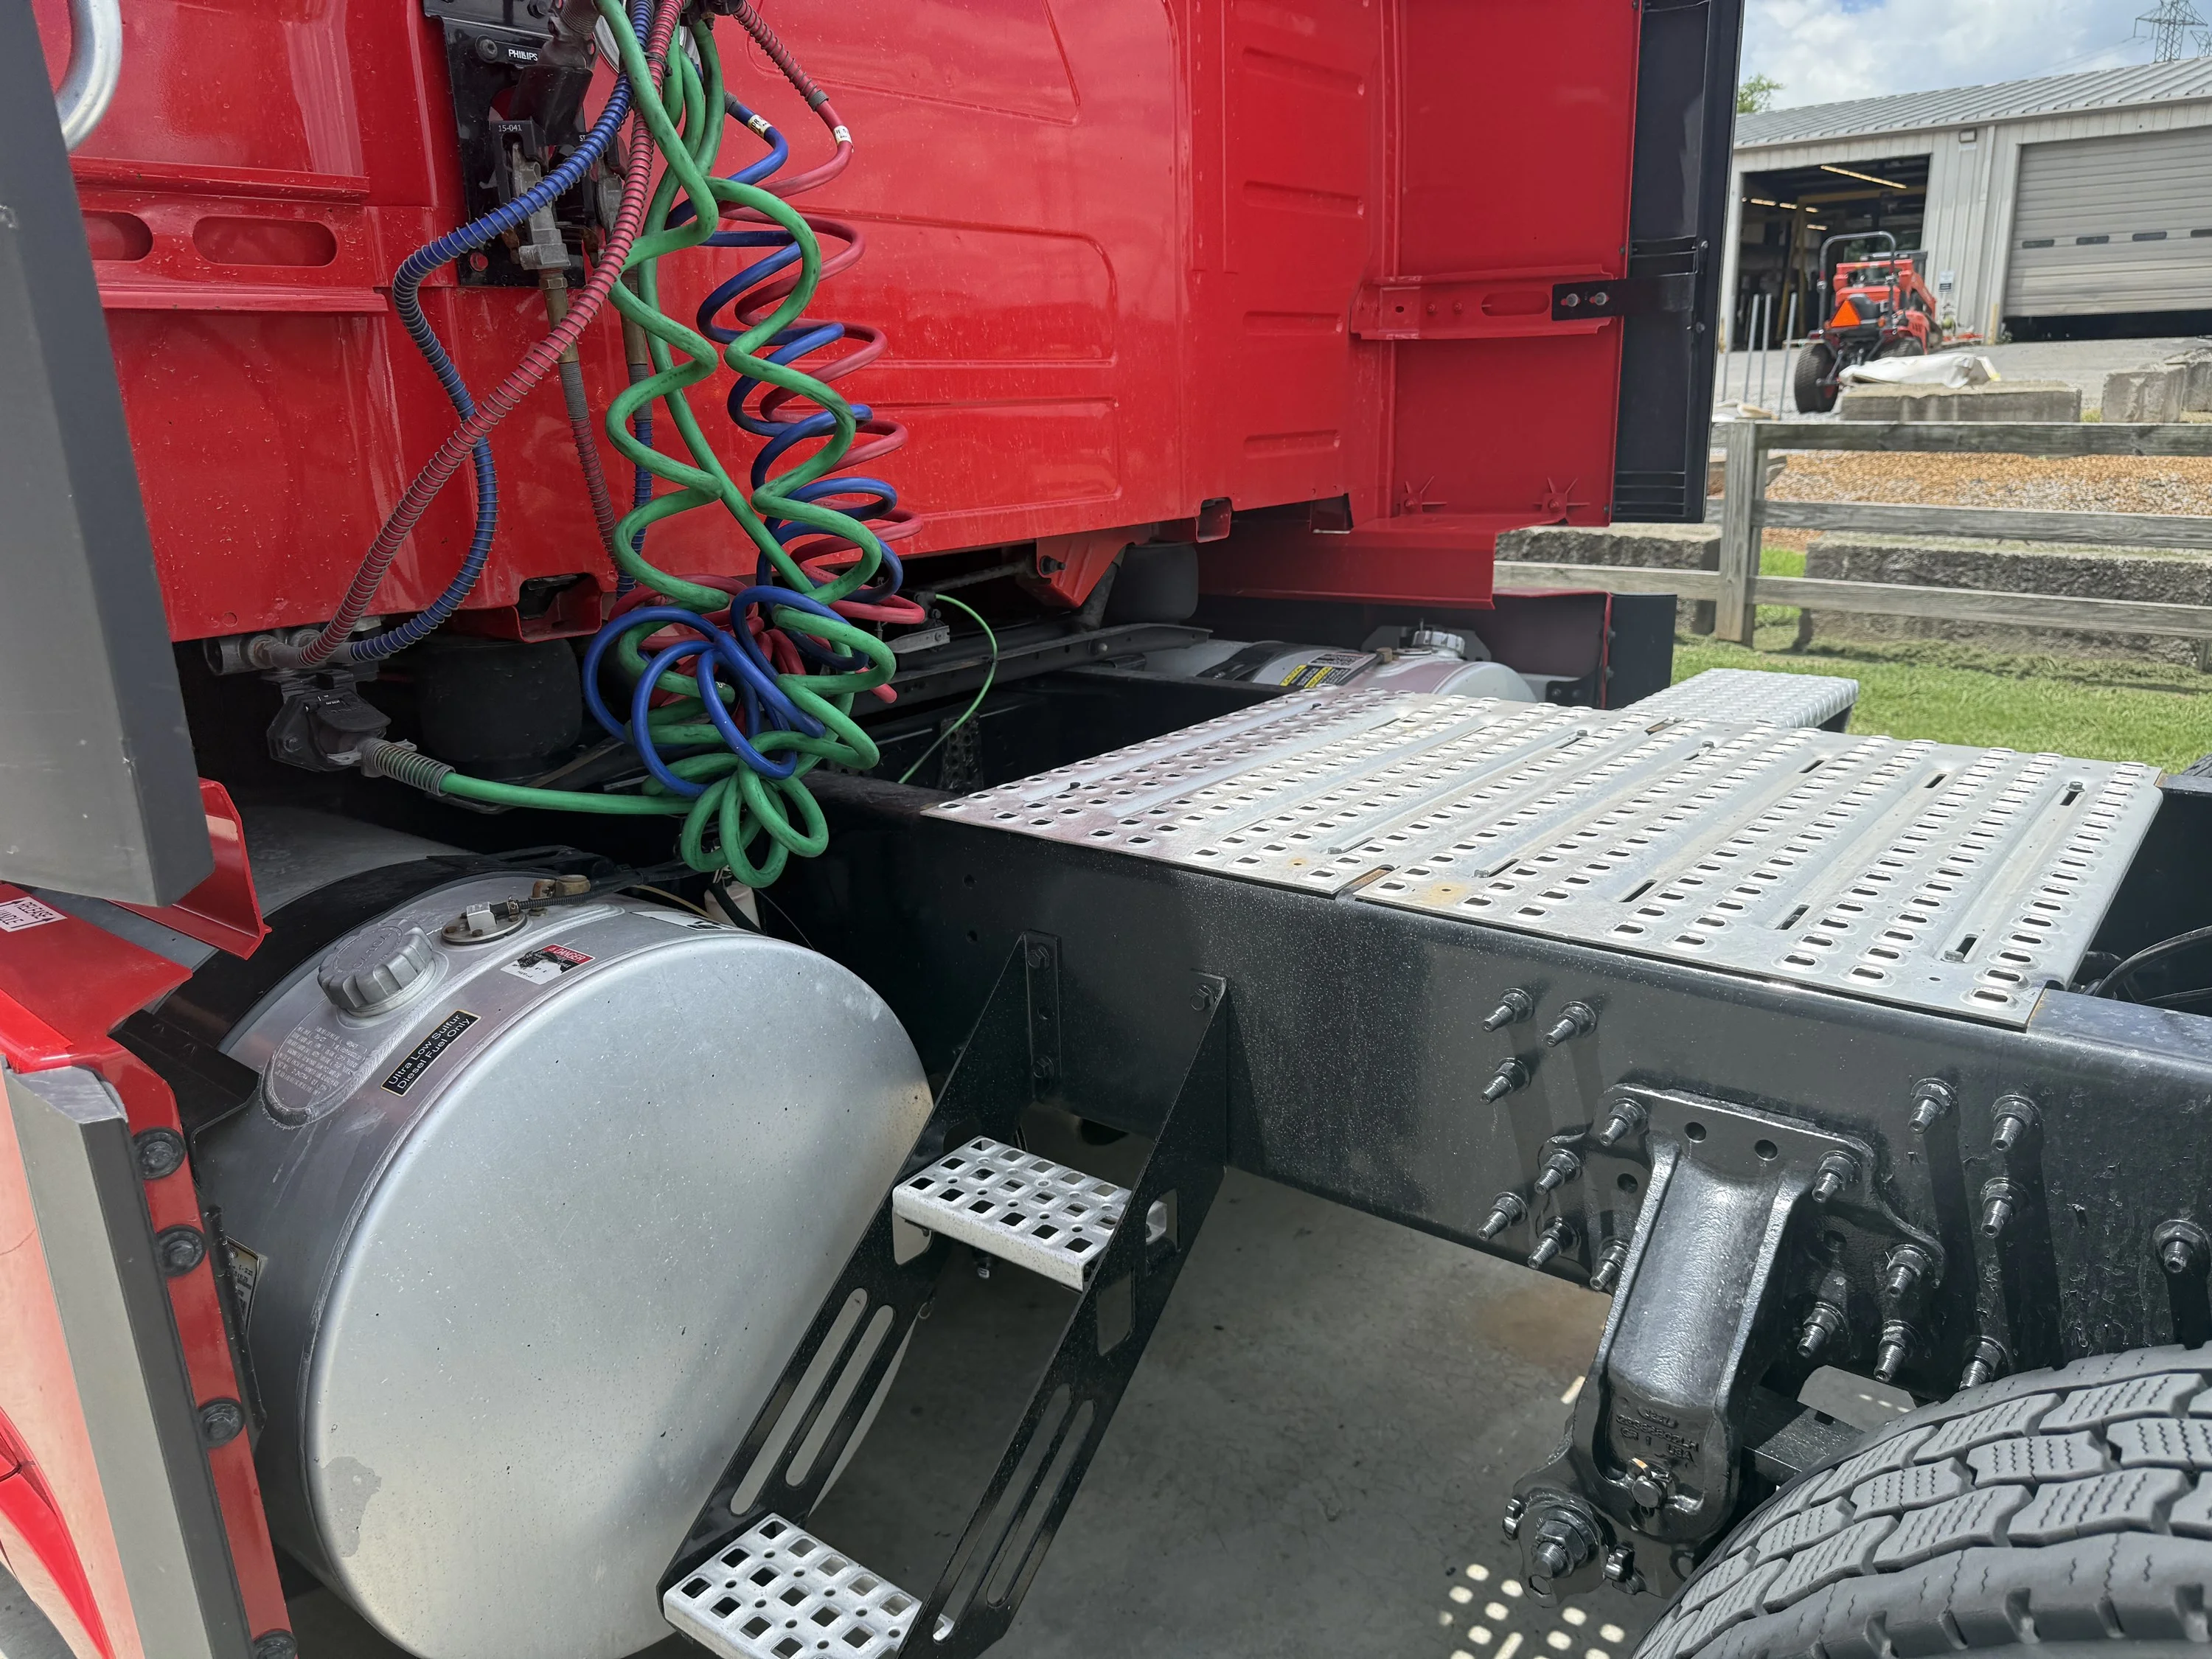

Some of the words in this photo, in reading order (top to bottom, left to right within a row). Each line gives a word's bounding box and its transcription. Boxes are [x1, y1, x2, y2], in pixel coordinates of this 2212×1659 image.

[508, 49, 538, 61] PHILLIPS
[498, 124, 522, 132] 15-041
[13, 902, 53, 919] RELEASE
[557, 948, 586, 962] DANGER
[388, 1062, 412, 1085] Ultra
[411, 1041, 432, 1061] Low
[431, 1015, 461, 1040] Sulfur
[397, 1059, 427, 1089] Diesel
[425, 1038, 448, 1059] Fuel
[447, 1018, 470, 1037] Only
